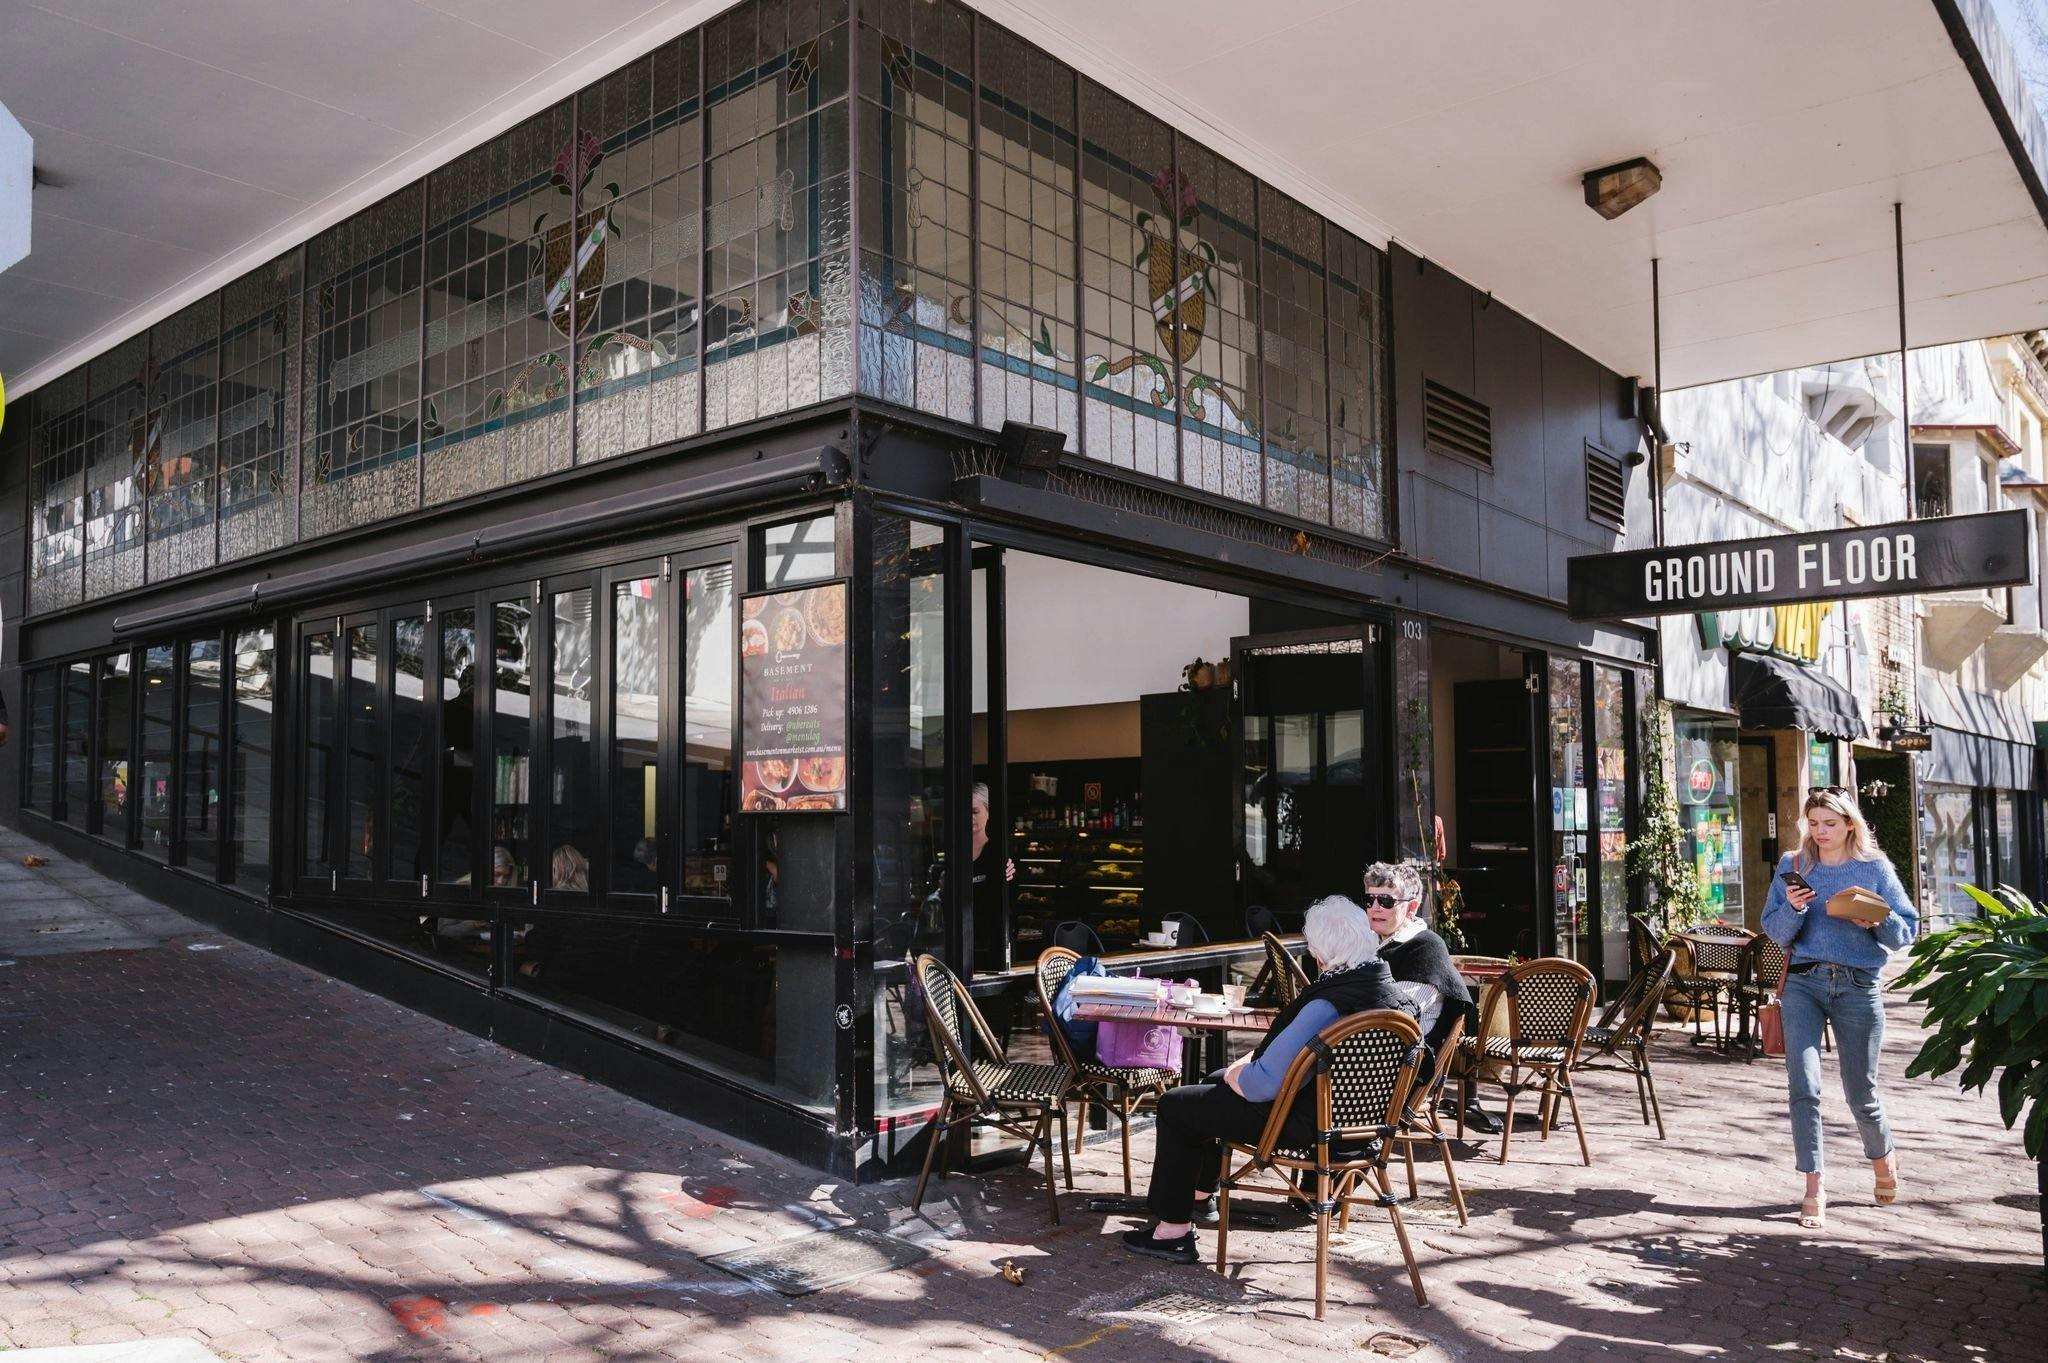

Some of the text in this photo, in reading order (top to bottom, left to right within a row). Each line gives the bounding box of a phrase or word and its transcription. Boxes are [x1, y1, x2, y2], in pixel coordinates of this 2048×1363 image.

[1645, 534, 1918, 602] GROUND FLOOR
[1402, 619, 1422, 641] 103
[764, 664, 812, 676] BASEMENT
[771, 683, 805, 700] Italian
[762, 706, 774, 718] Pick
[787, 706, 802, 715] 4906
[804, 705, 817, 715] 1386
[1898, 737, 1928, 748] OPEN
